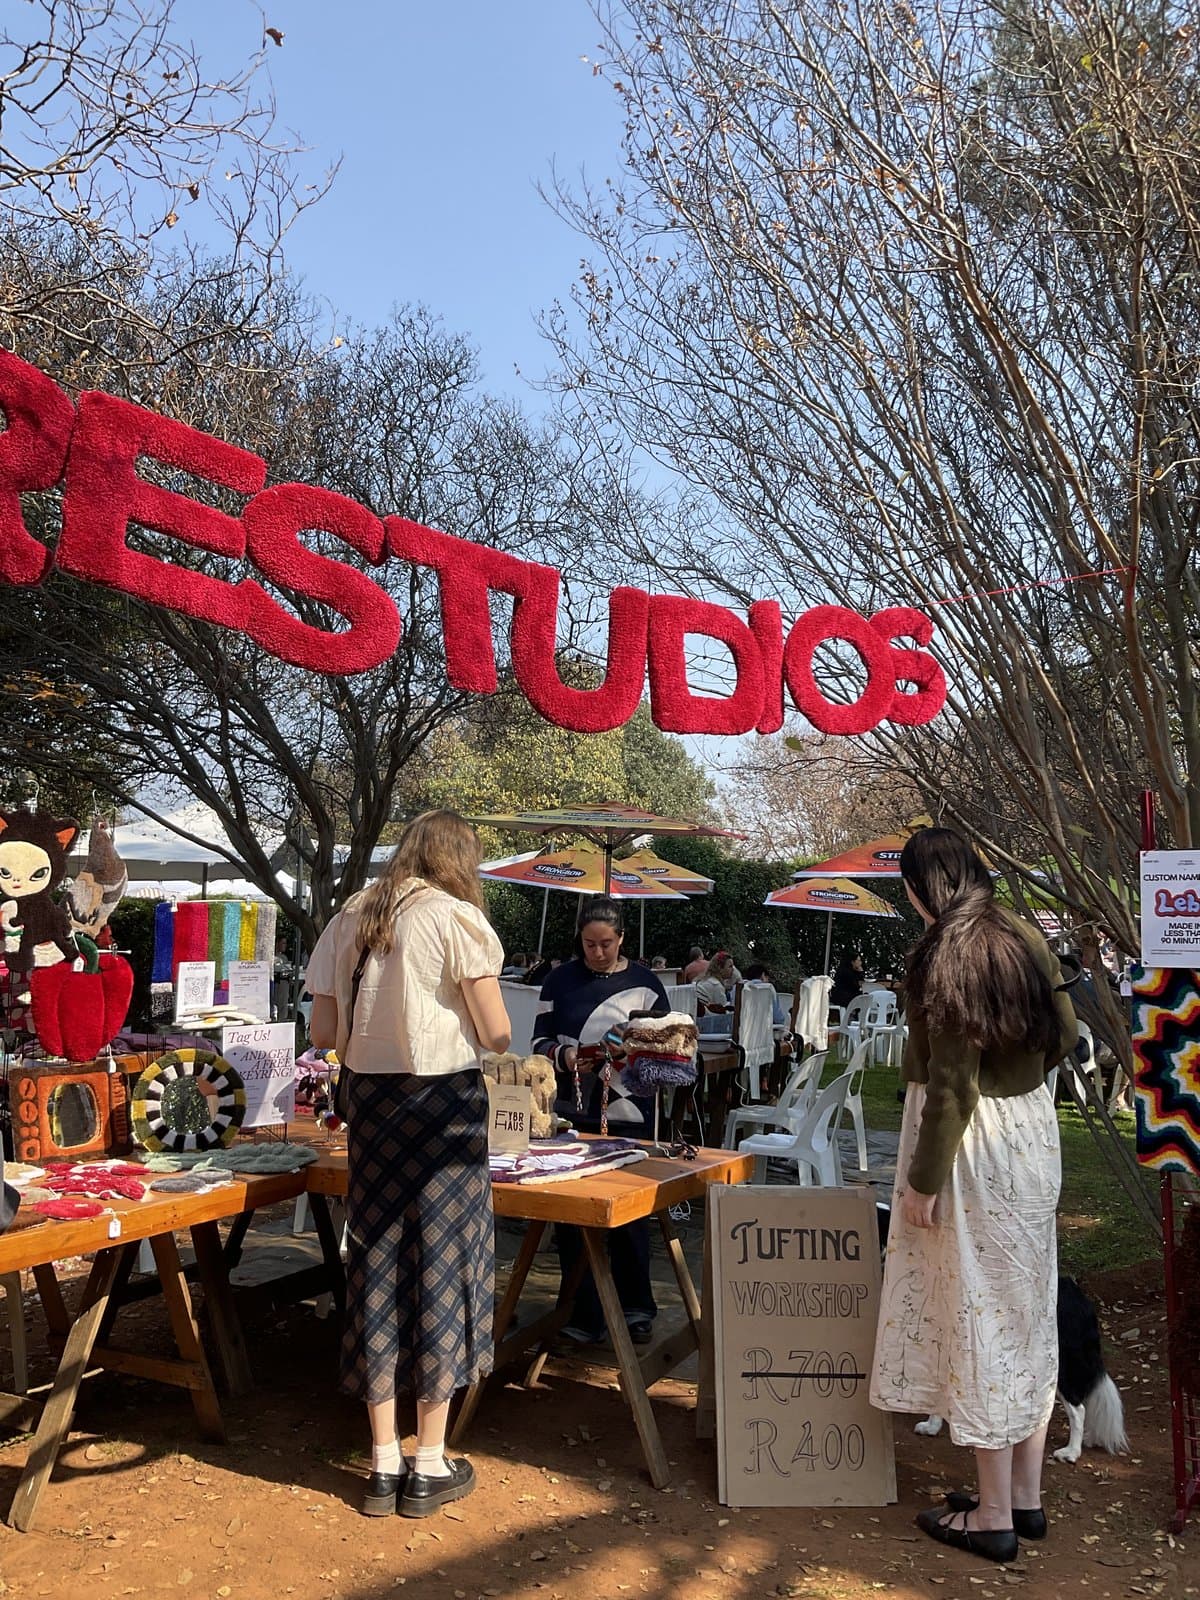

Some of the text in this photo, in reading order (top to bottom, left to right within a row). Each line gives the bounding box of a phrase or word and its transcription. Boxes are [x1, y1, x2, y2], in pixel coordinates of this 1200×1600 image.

[535, 864, 584, 877] STRONGBOW
[1143, 873, 1177, 881] CUSTOM
[810, 890, 856, 900] STRONGBOW
[1164, 929, 1184, 937] LESS
[1168, 922, 1193, 930] MADE
[1160, 937, 1172, 945] 90
[228, 1029, 271, 1046] Tag Us!
[240, 1047, 293, 1062] AND GET
[252, 1057, 292, 1071] A FREE
[239, 1067, 293, 1081] KEYRING!
[731, 1218, 861, 1265] TUFTING
[729, 1280, 869, 1318] WORKSHOP
[787, 1350, 858, 1399] 700
[792, 1420, 865, 1472] 400
